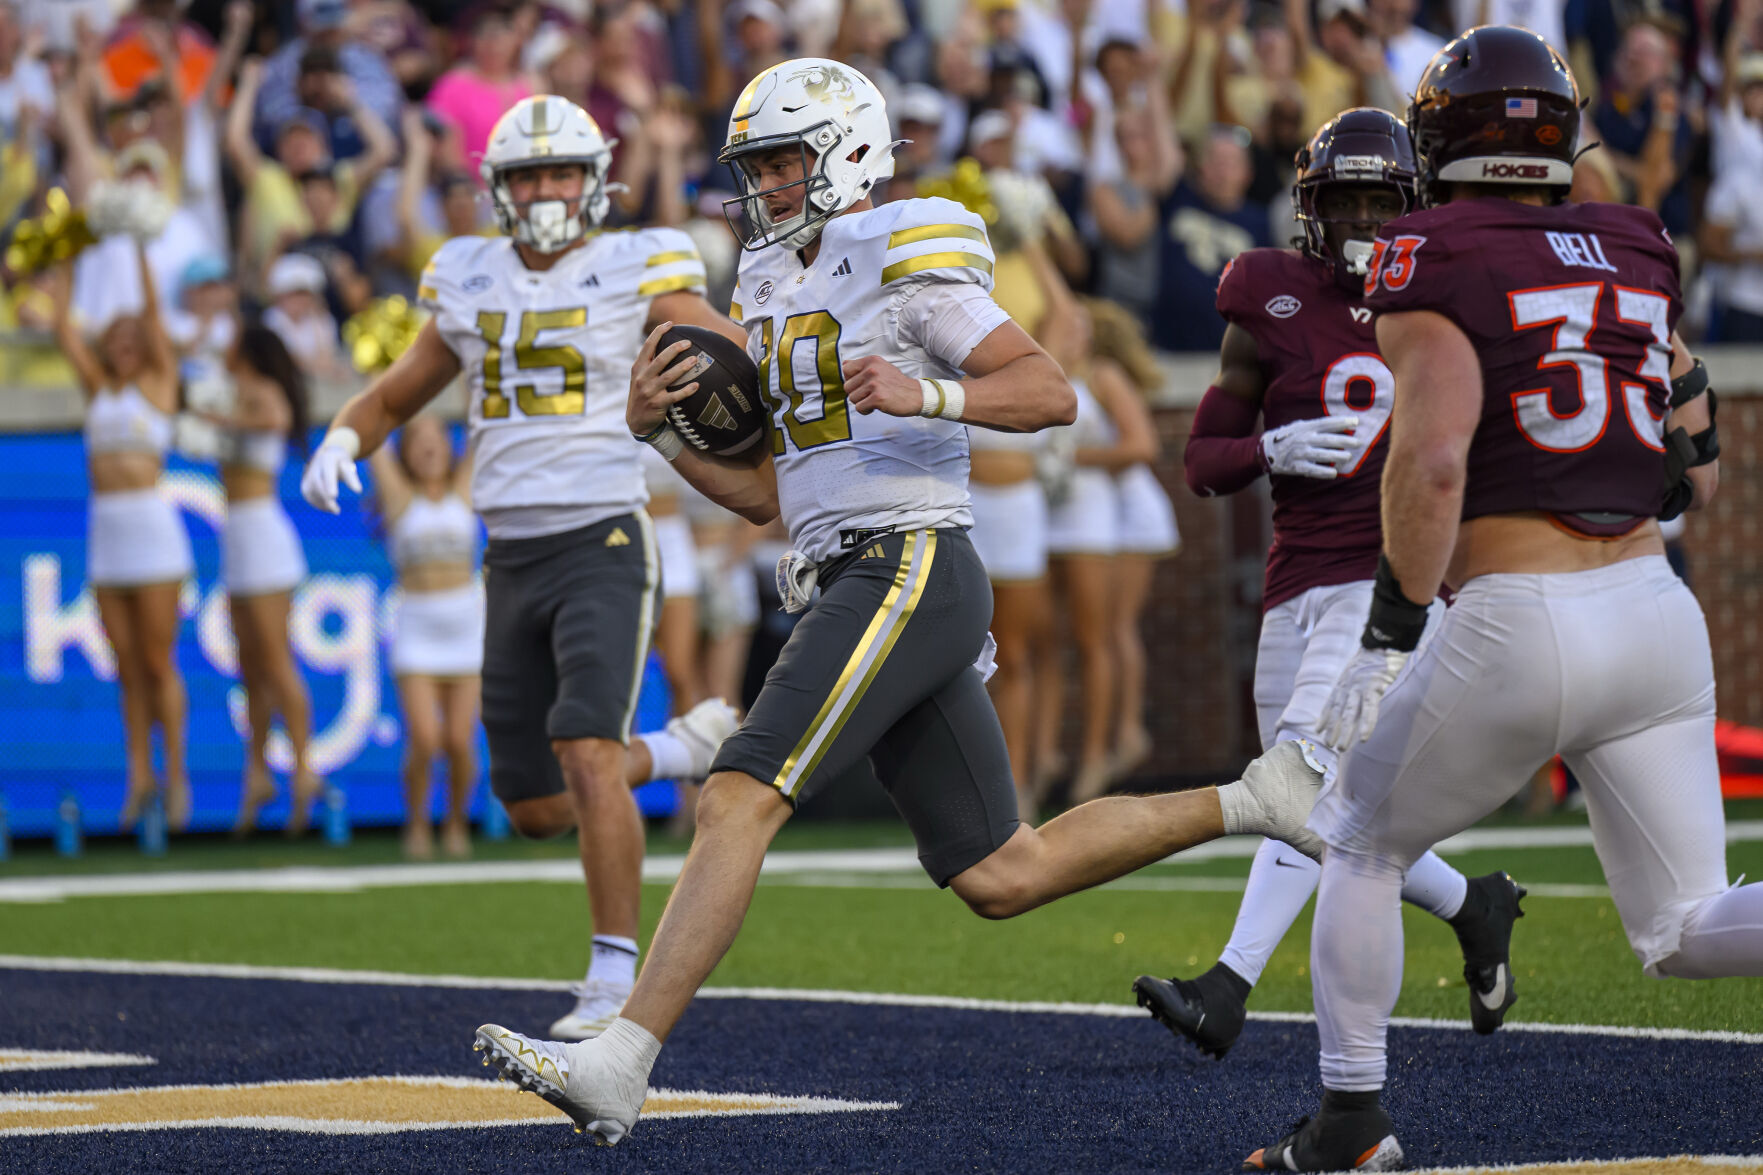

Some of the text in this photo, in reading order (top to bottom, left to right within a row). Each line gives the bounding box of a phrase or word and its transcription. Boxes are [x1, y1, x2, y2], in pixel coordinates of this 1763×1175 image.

[1482, 163, 1550, 179] HOKIES
[1545, 231, 1618, 273] BELL
[476, 306, 588, 419] 15
[757, 309, 853, 457] 10
[1320, 351, 1396, 477] 9
[1506, 281, 1673, 454] 33
